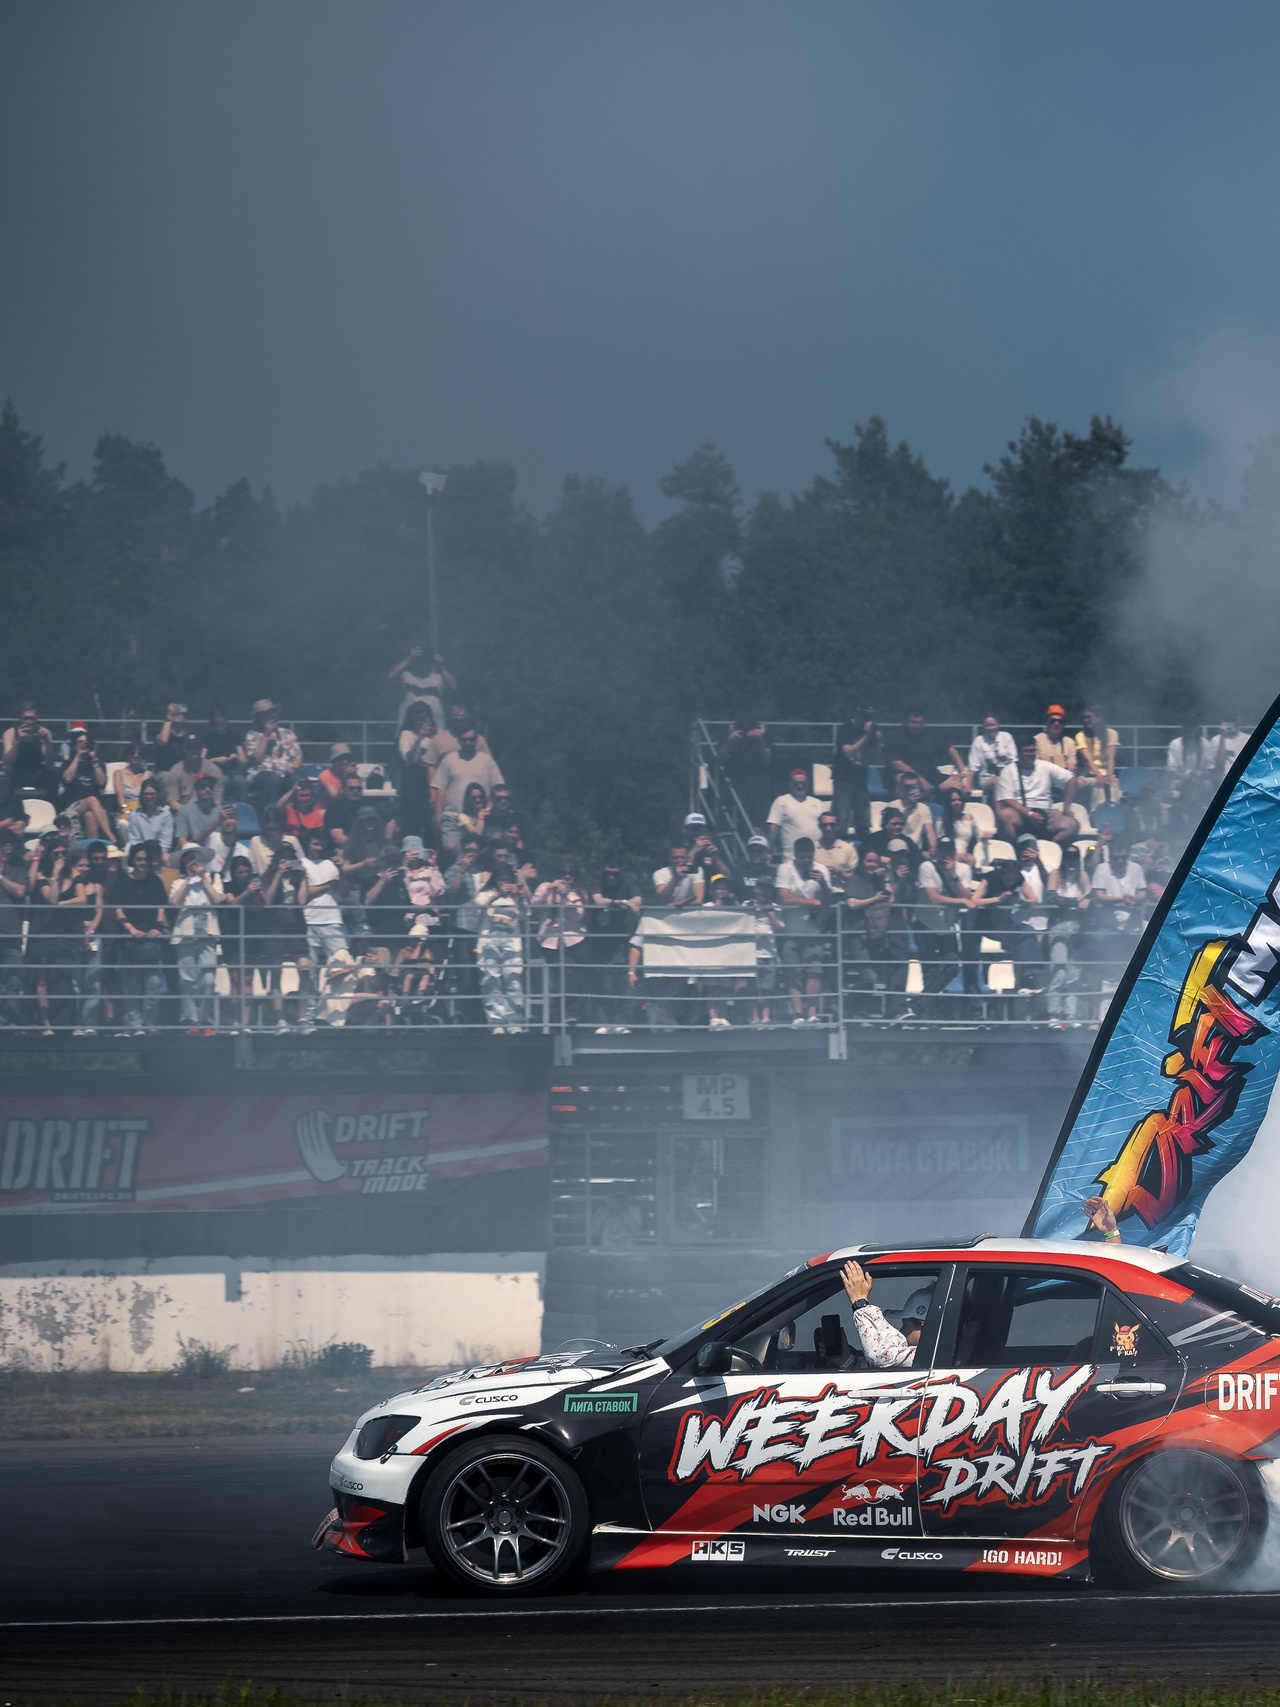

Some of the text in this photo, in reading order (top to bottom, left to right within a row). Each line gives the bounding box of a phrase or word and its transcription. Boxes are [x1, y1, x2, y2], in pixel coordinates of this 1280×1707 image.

[698, 1098, 736, 1116] 4.5
[335, 1110, 429, 1143] DRIFT
[1, 1119, 149, 1190] DRIFT
[474, 1394, 518, 1404] CUSCO
[570, 1398, 631, 1412] ЛИГА СТАВОК
[677, 1364, 1098, 1480] WEEKDAY
[923, 1444, 1113, 1502] DRIFT
[753, 1503, 806, 1524] NGK
[833, 1506, 913, 1526] Red Bull
[691, 1541, 745, 1561] HKS
[898, 1552, 943, 1560] CUSCO
[982, 1550, 1063, 1566] !GO HARD!
